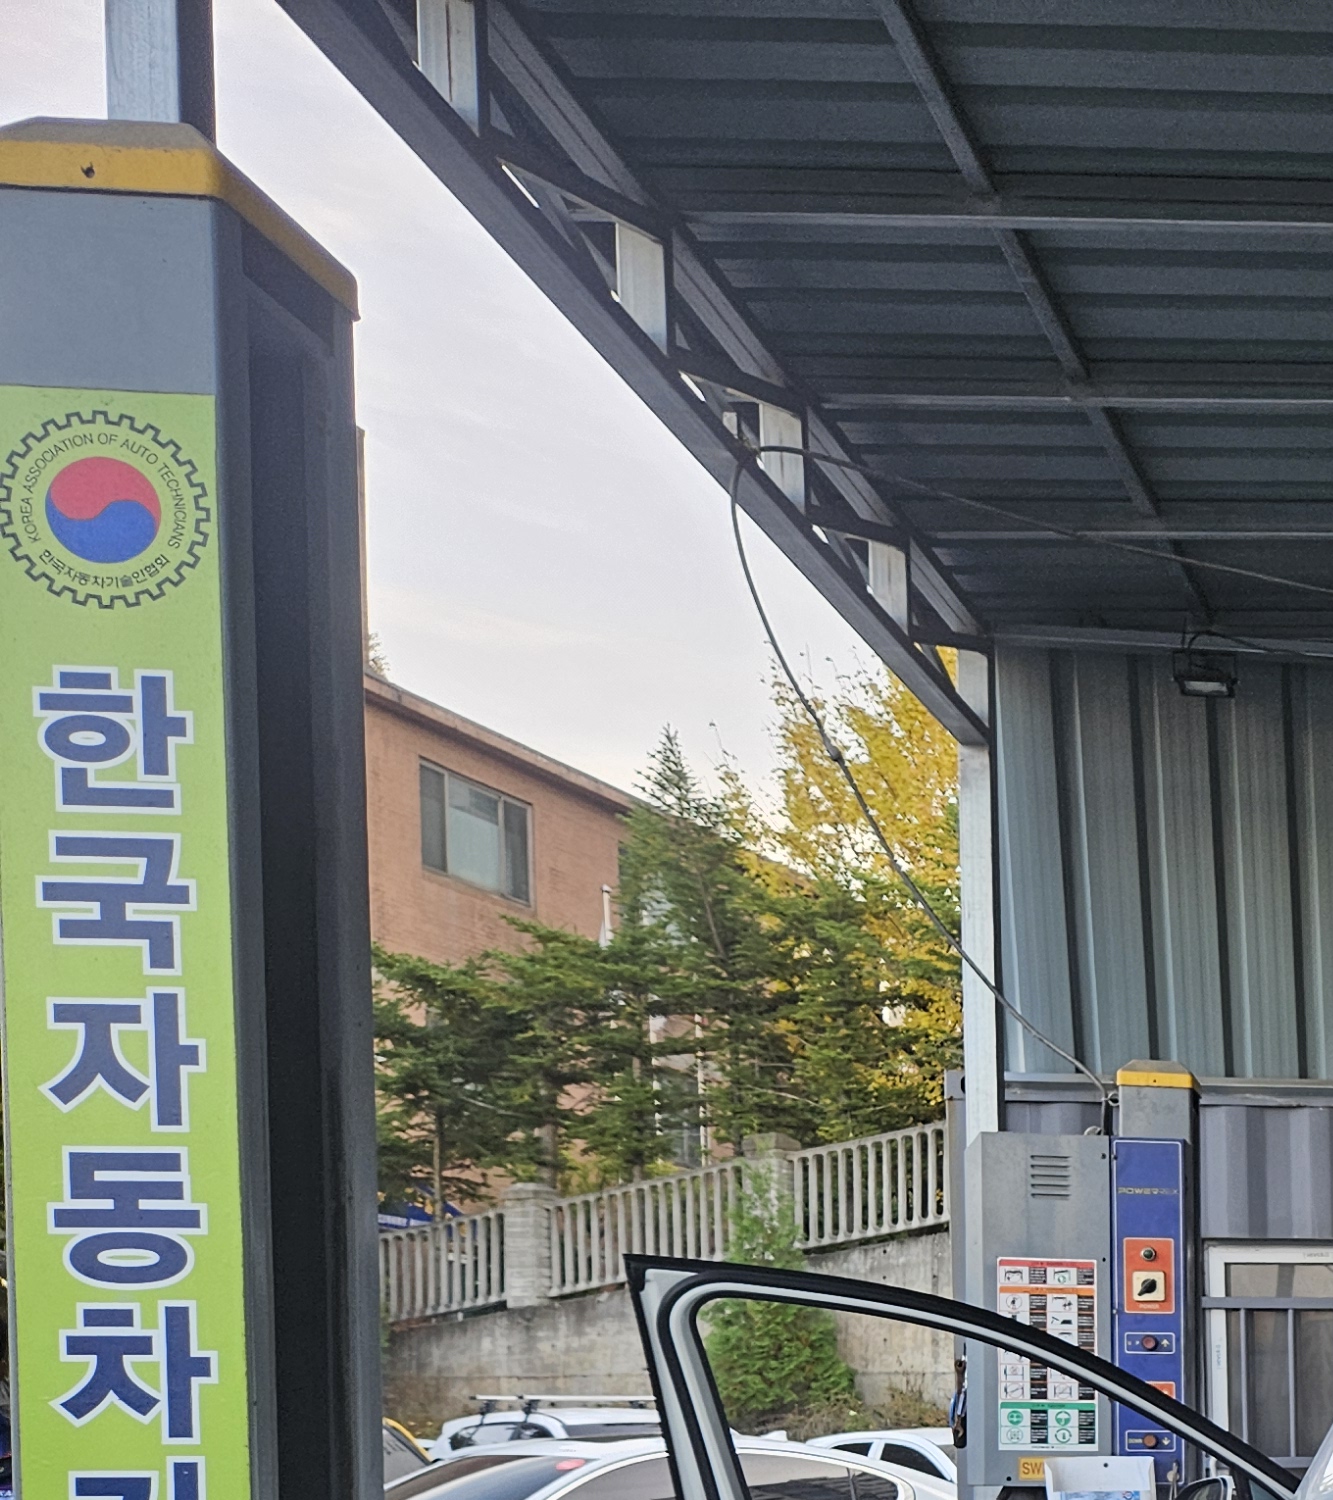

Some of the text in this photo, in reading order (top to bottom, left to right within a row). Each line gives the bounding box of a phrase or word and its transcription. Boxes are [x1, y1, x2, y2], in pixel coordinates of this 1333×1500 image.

[20, 432, 188, 549] KOREA ASSOCIATION OF AUTO TECHNICIANS
[38, 548, 171, 589] 한국자동차기술인협회
